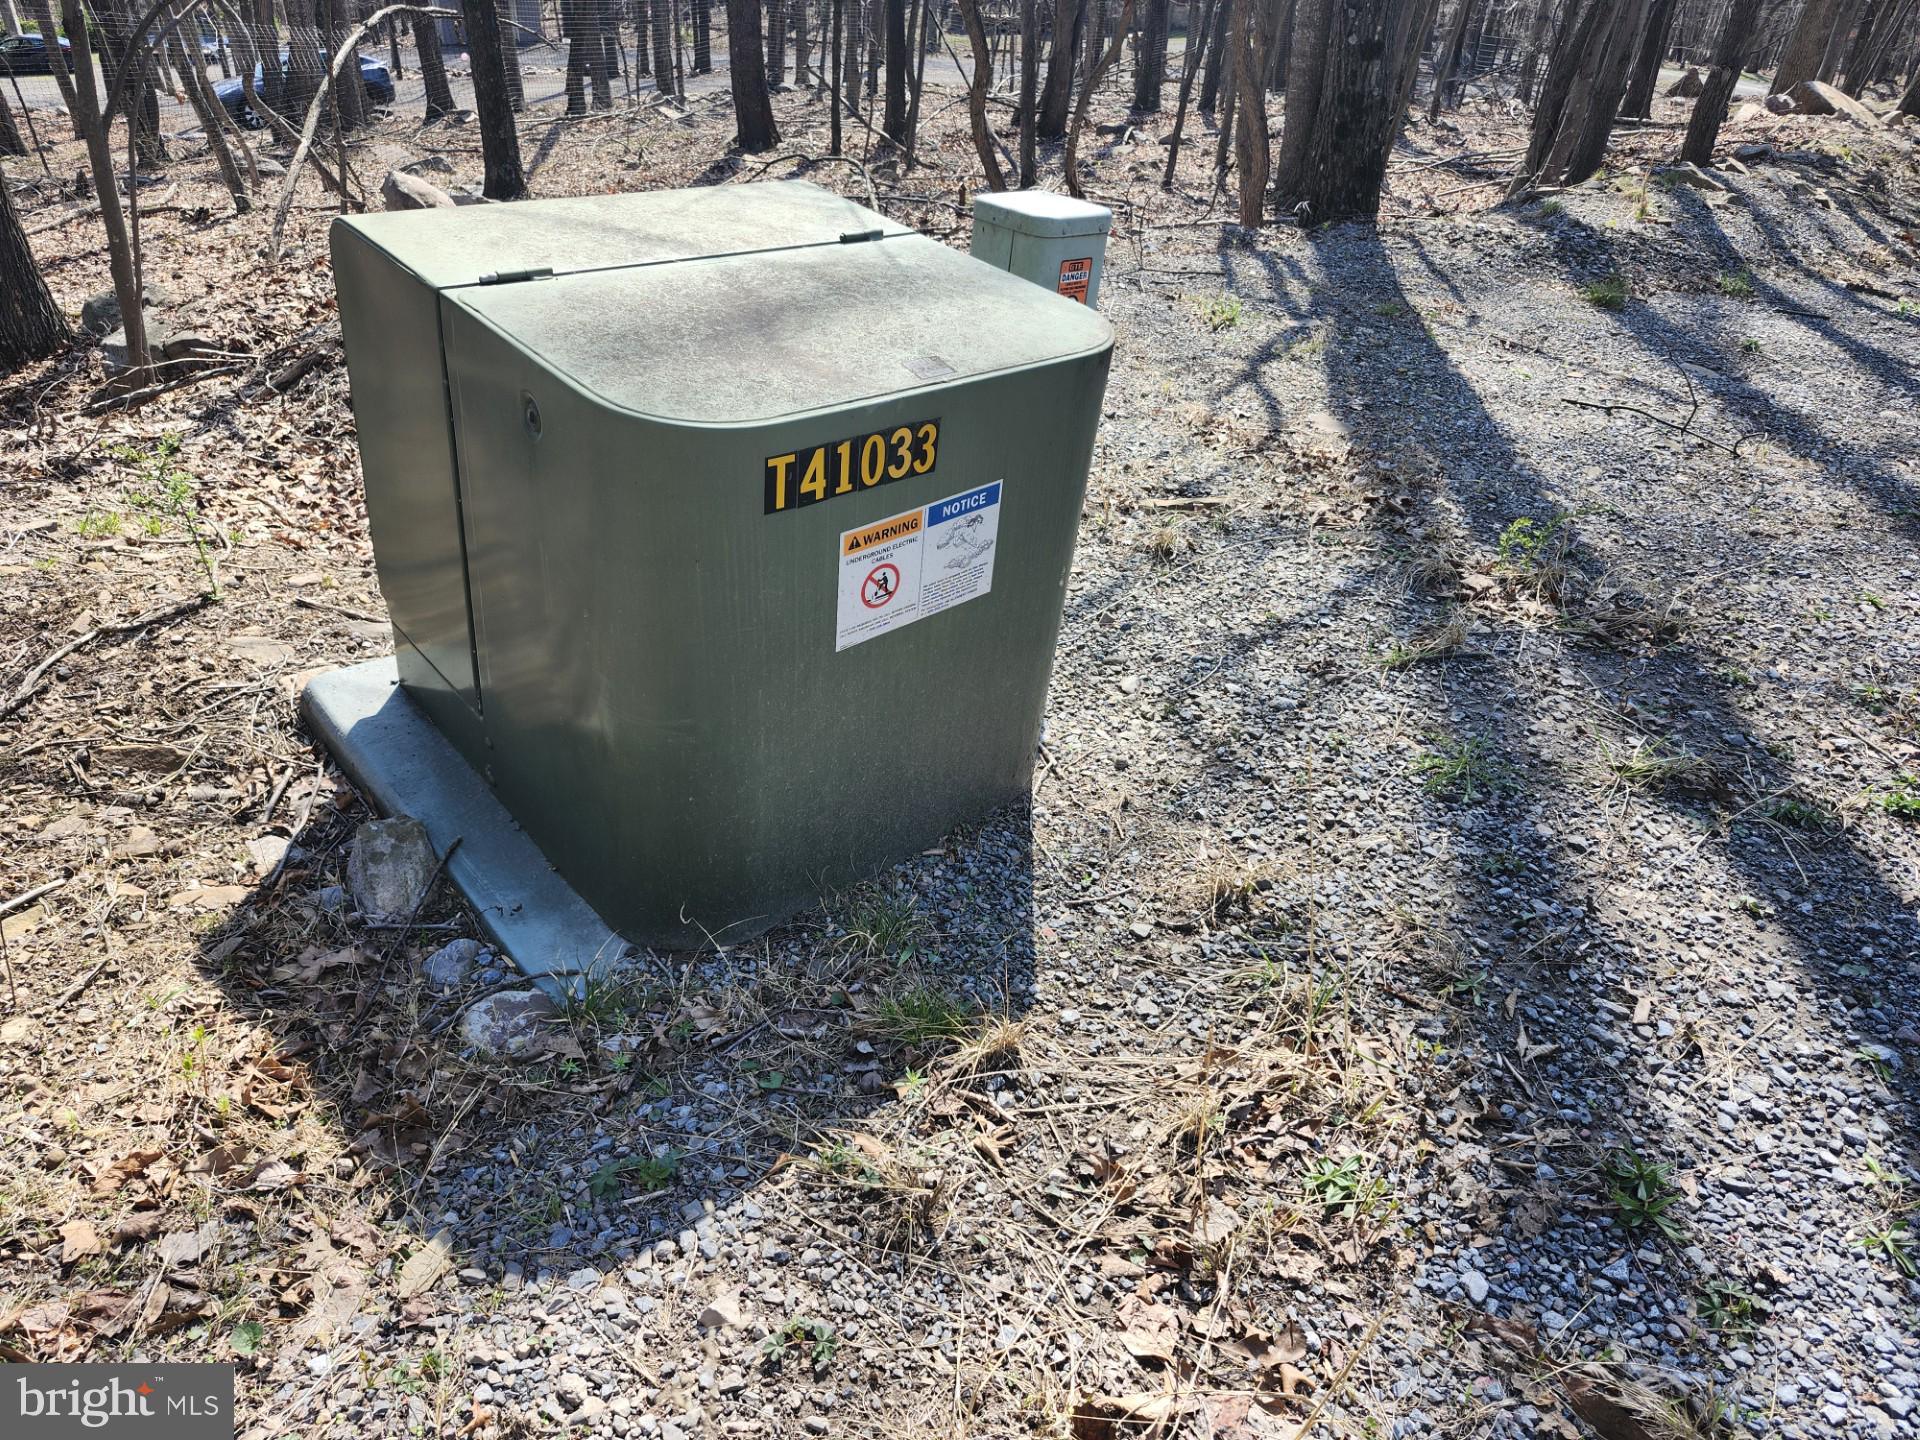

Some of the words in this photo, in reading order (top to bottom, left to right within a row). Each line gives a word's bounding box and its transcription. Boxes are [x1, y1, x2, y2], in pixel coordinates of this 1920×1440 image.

[1062, 271, 1088, 282] DANGER
[767, 423, 937, 510] T41033
[942, 492, 987, 518] NOTICE
[863, 518, 919, 546] WARNING
[846, 545, 892, 566] UNDERGROUND
[892, 536, 919, 551] ELECTRIC
[871, 552, 894, 564] CABLES
